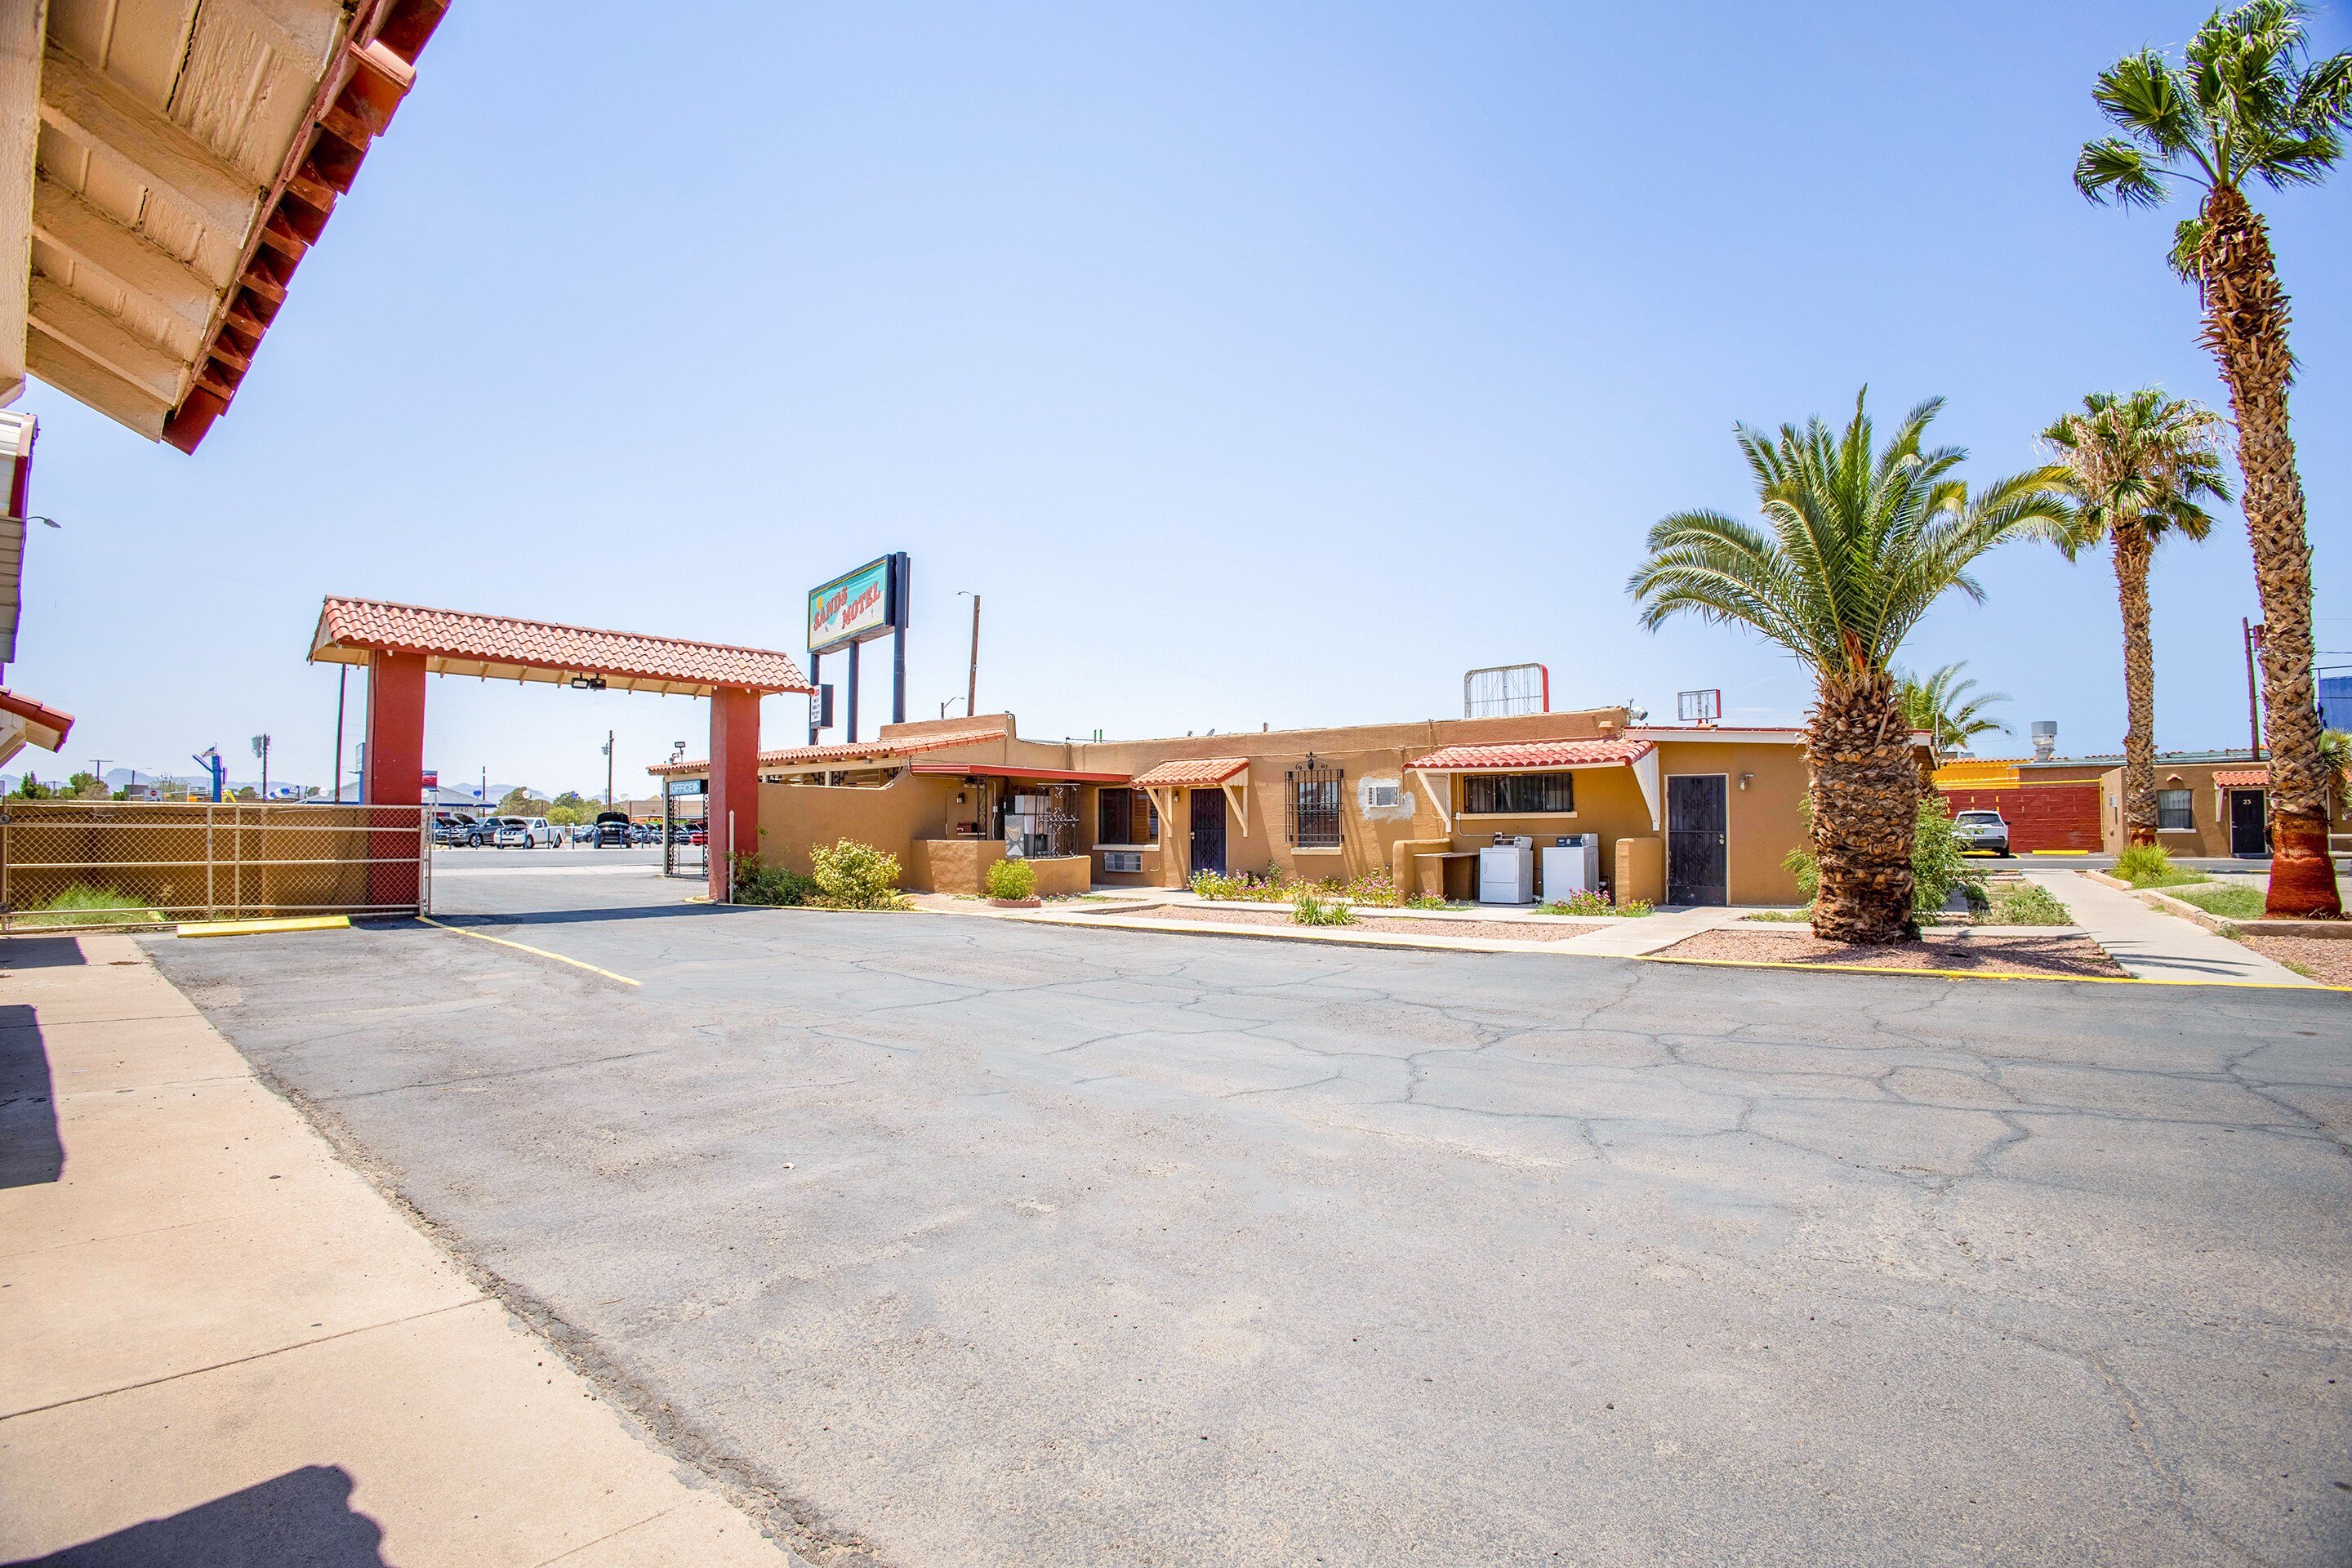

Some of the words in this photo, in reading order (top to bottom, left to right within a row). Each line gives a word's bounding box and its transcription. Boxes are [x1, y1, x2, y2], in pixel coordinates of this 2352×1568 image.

[813, 586, 848, 631] SANDS
[841, 581, 880, 630] MOTEL
[671, 783, 693, 793] OFFICE
